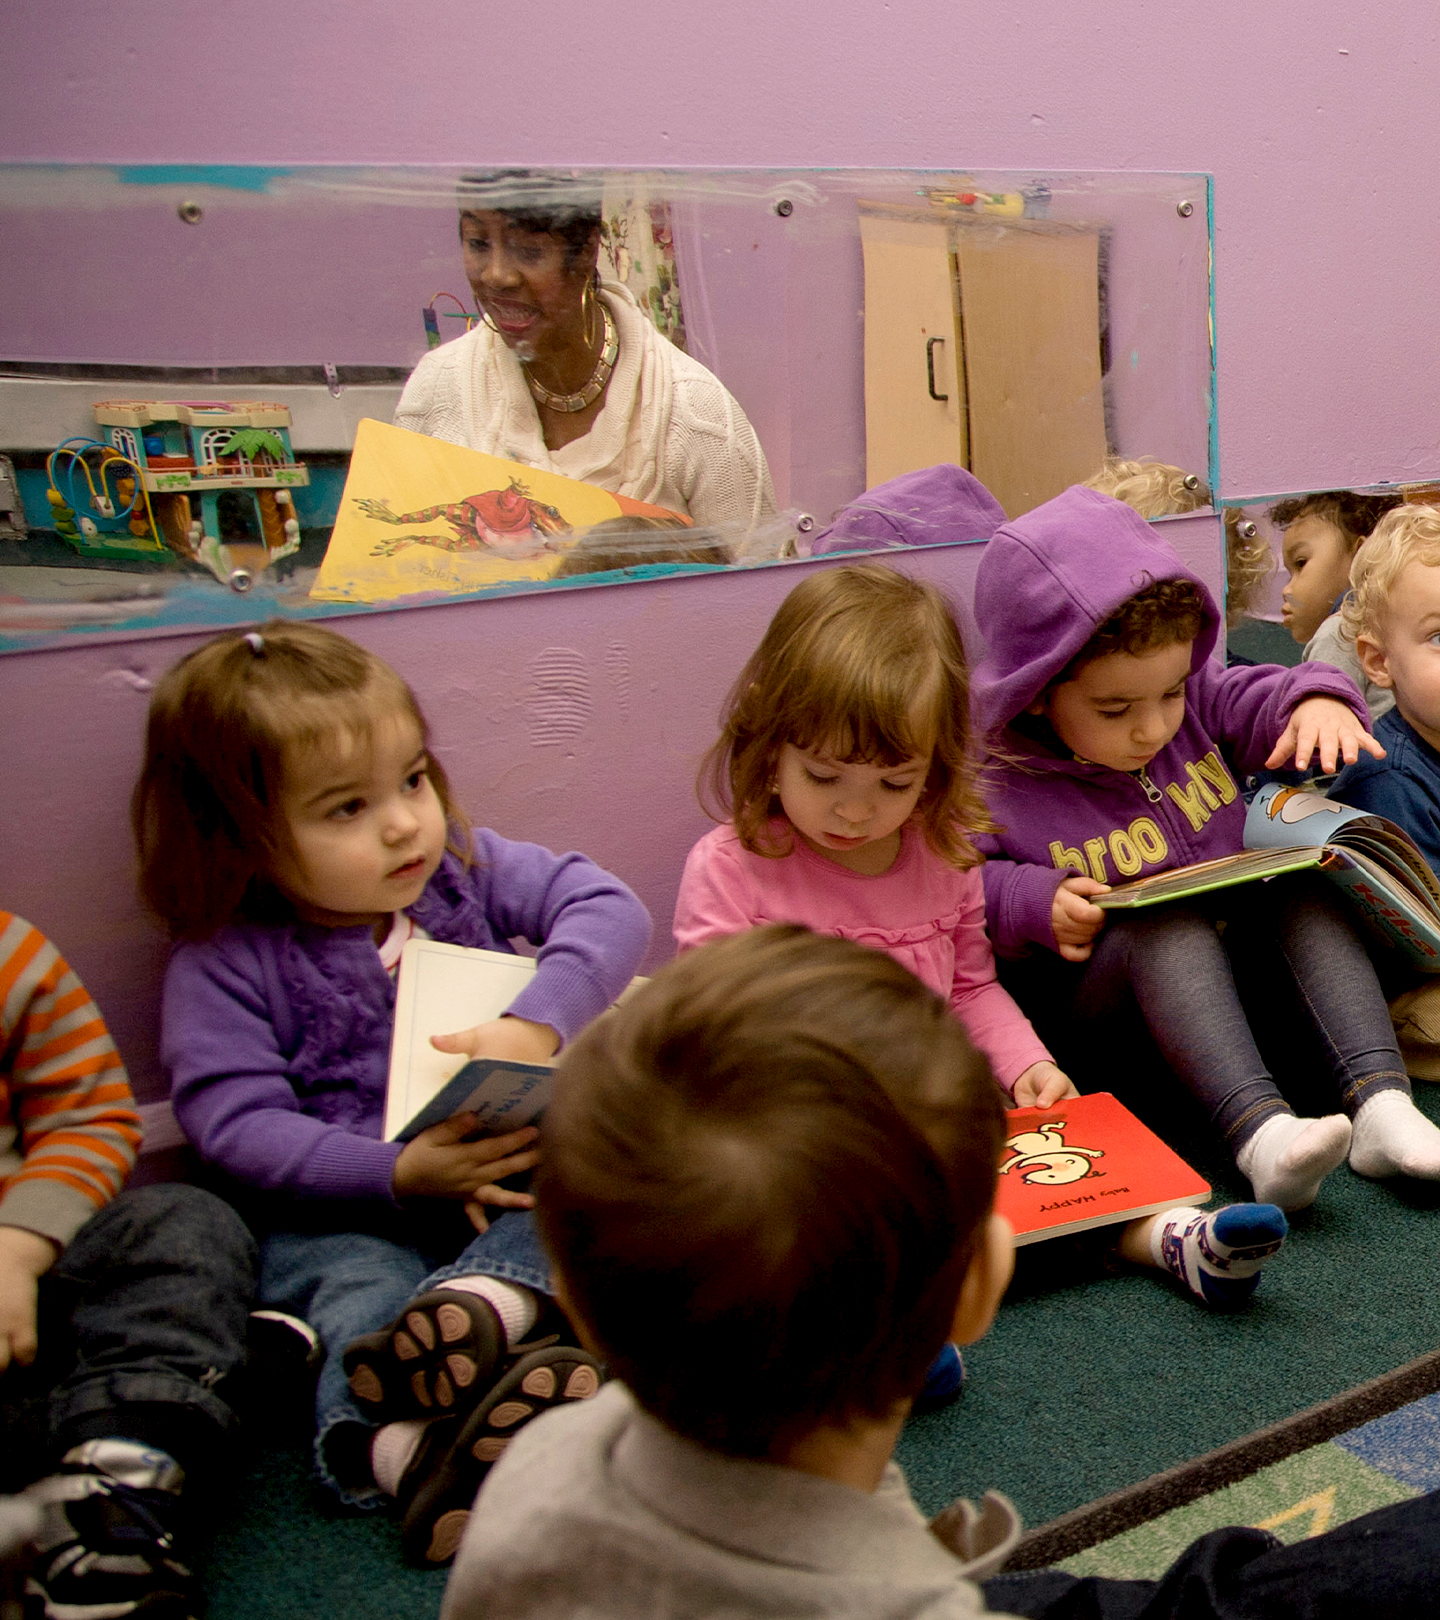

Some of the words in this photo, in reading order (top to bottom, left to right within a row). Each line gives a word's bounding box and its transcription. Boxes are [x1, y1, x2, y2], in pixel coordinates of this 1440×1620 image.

[1350, 882, 1438, 959] Kika
[1099, 1186, 1131, 1197] Baby
[1040, 1194, 1096, 1212] HAPPY
